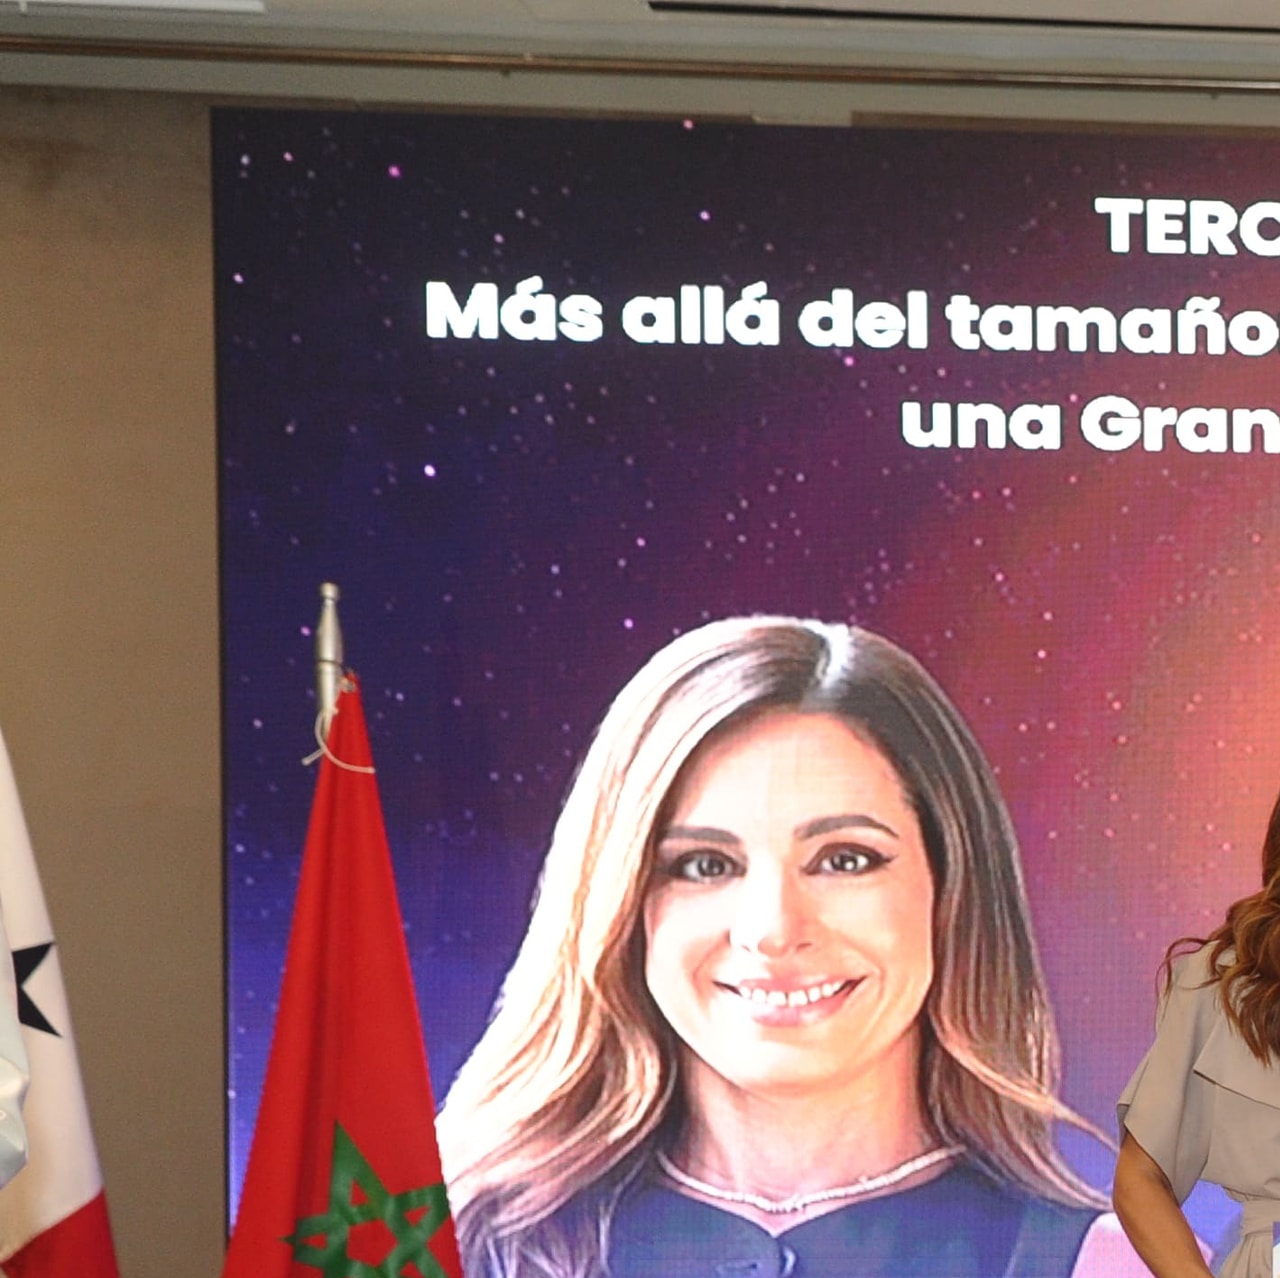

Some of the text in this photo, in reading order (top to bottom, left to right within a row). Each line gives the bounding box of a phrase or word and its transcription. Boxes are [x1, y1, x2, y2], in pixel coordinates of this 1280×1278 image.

[426, 275, 603, 342] Más
[622, 280, 780, 346] allá
[798, 288, 928, 349] del
[902, 401, 1061, 450] una
